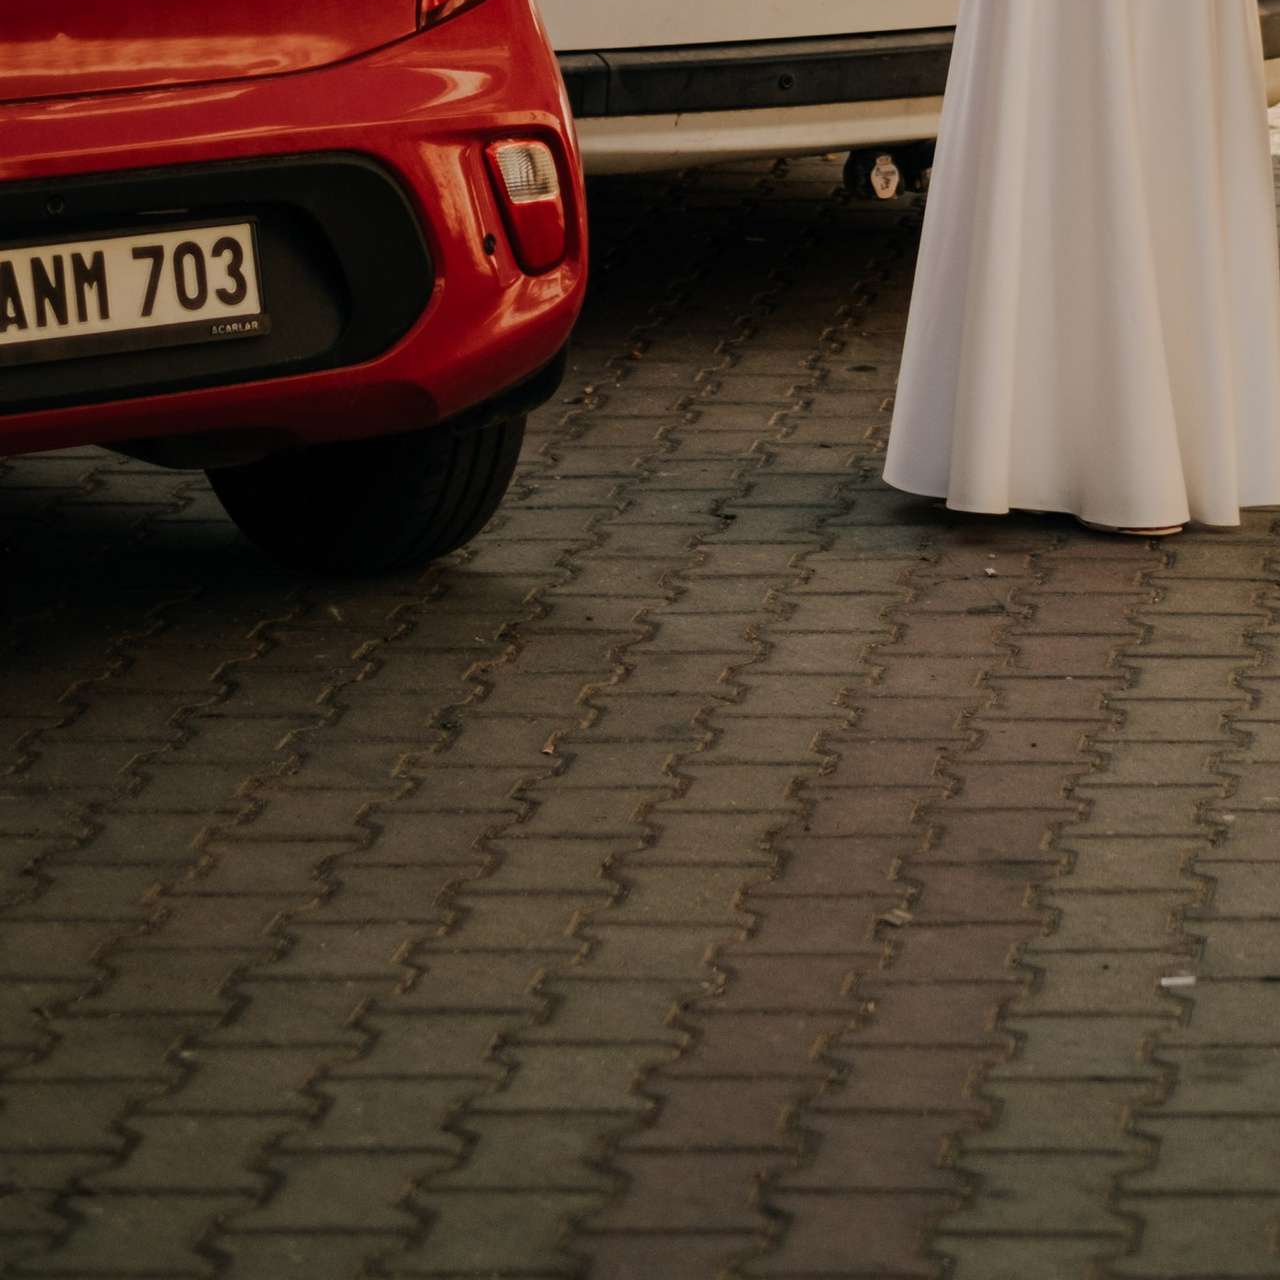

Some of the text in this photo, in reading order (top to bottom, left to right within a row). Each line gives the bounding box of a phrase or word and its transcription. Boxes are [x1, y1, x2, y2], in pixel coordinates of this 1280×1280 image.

[0, 236, 248, 333] ANM 703
[211, 320, 259, 336] ACARLAR
